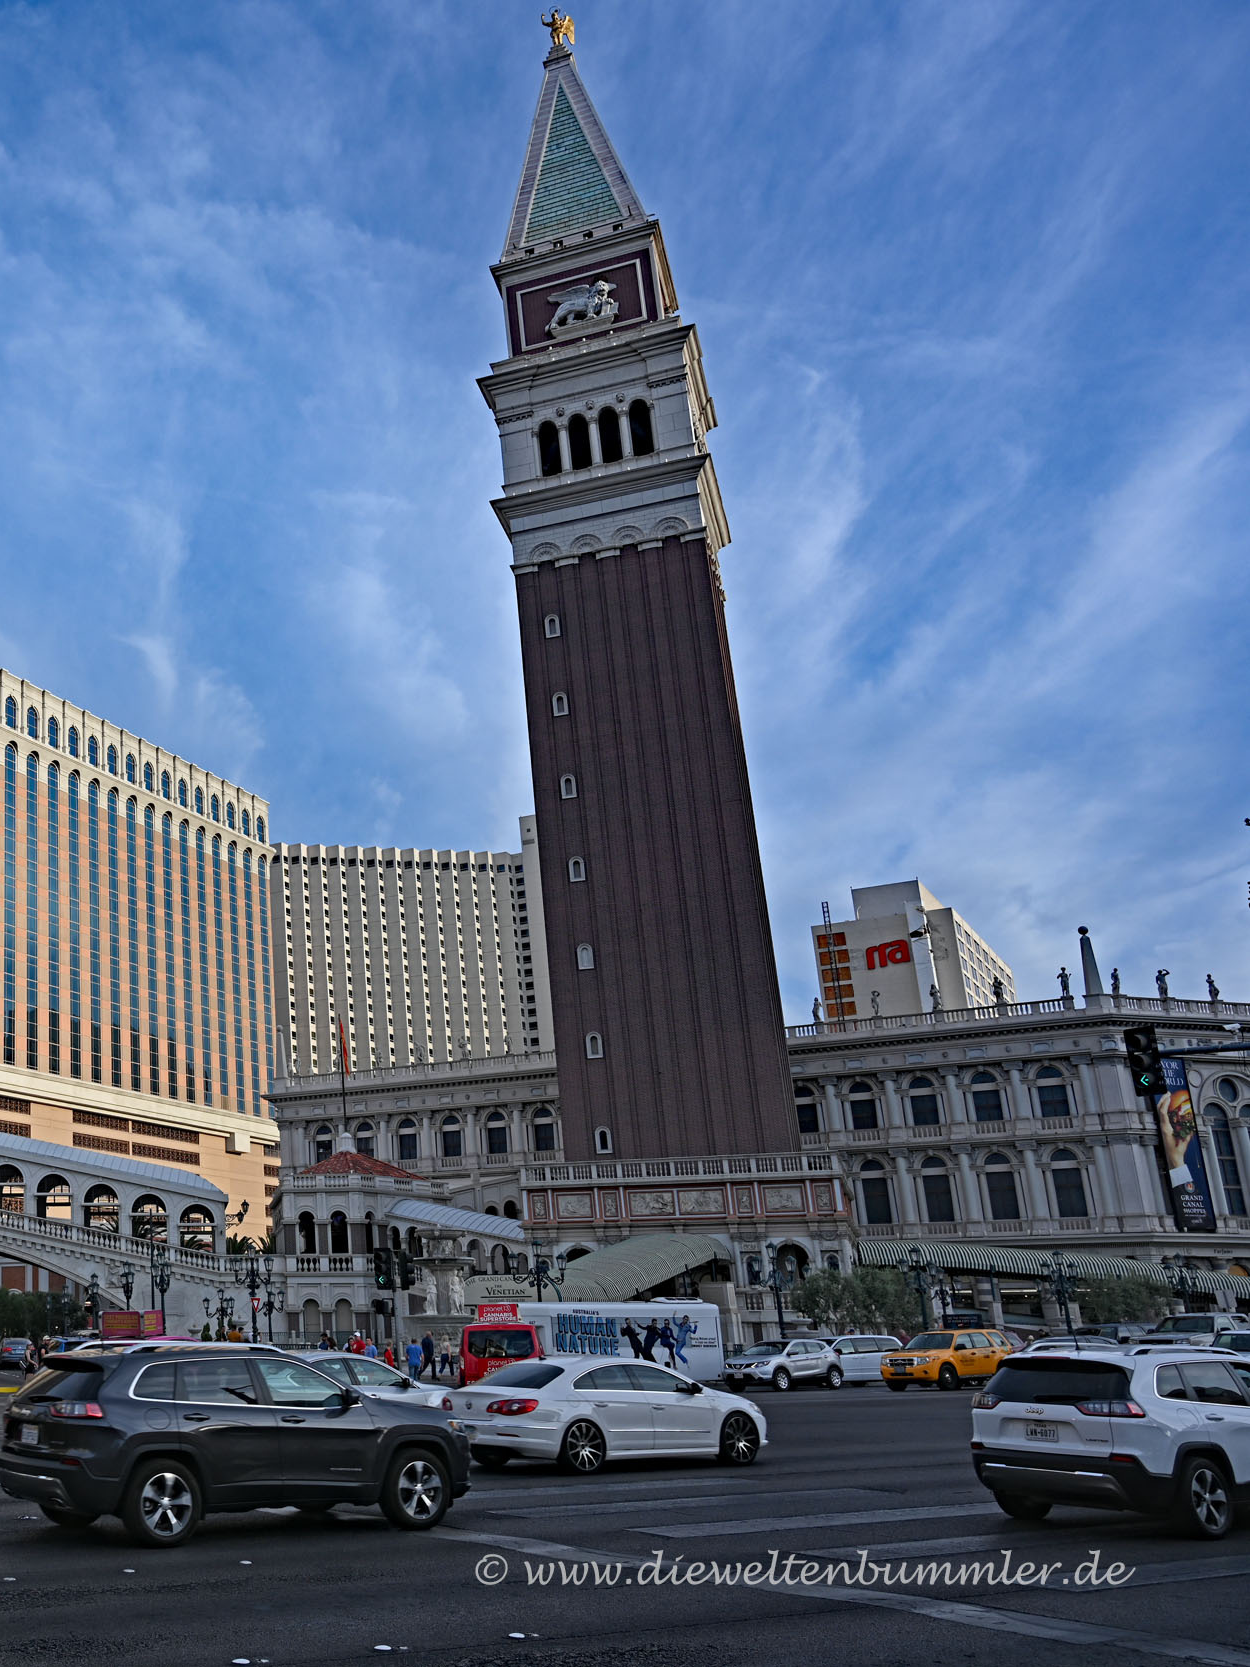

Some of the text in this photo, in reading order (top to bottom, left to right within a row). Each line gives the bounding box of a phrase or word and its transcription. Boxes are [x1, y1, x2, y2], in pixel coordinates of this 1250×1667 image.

[572, 1308, 600, 1316] AUSTRALIA'S
[556, 1313, 618, 1338] HUMAN
[555, 1333, 621, 1356] NATURE
